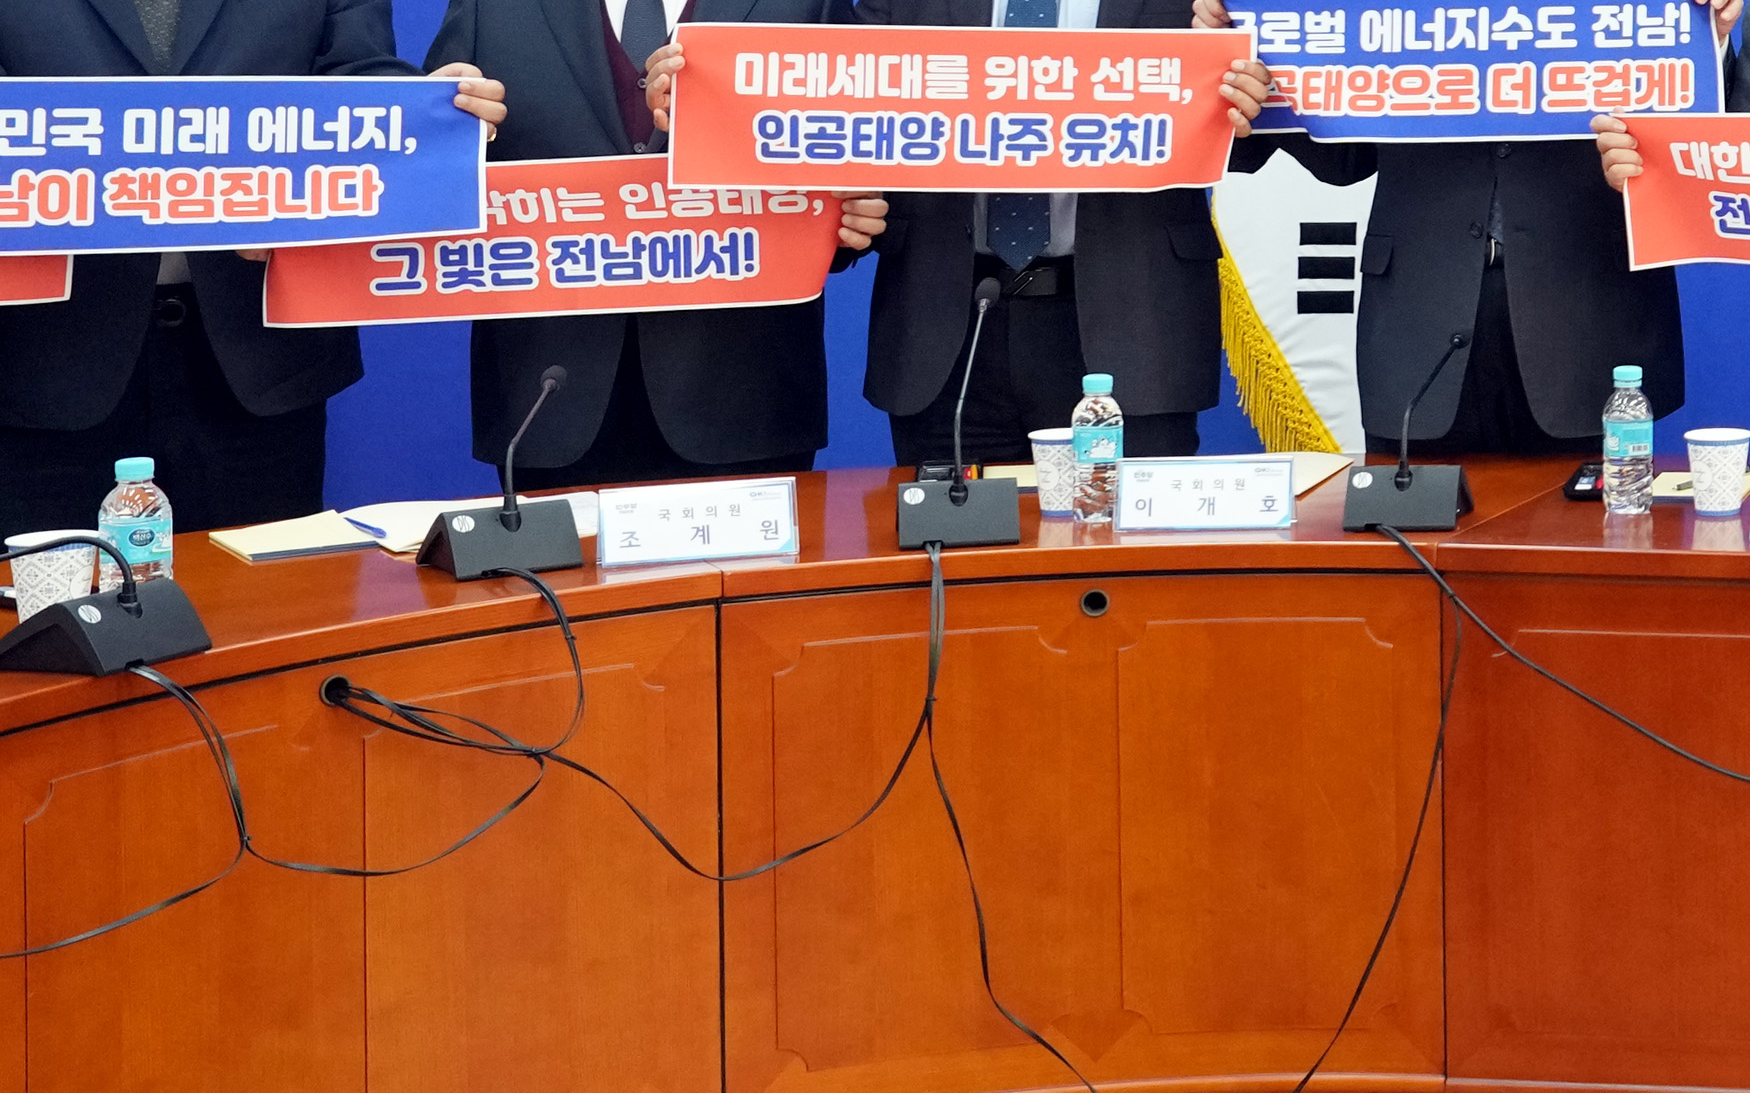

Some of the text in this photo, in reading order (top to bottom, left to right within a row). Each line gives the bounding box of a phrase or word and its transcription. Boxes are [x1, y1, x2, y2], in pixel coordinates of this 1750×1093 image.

[1359, 4, 1579, 54] 에너지수도
[1590, 1, 1692, 49] 전남!
[733, 51, 1195, 106] 미래세대를 위한 선택,
[1486, 60, 1537, 116] 더
[1542, 57, 1697, 115] 뜨겁게!
[122, 105, 230, 155] 미래
[246, 104, 418, 156] 에너지,
[752, 109, 1174, 168] 인공태양 나주 유치!
[102, 163, 384, 225] 책임집니다
[369, 226, 761, 297] 그 빛은 전남에서!
